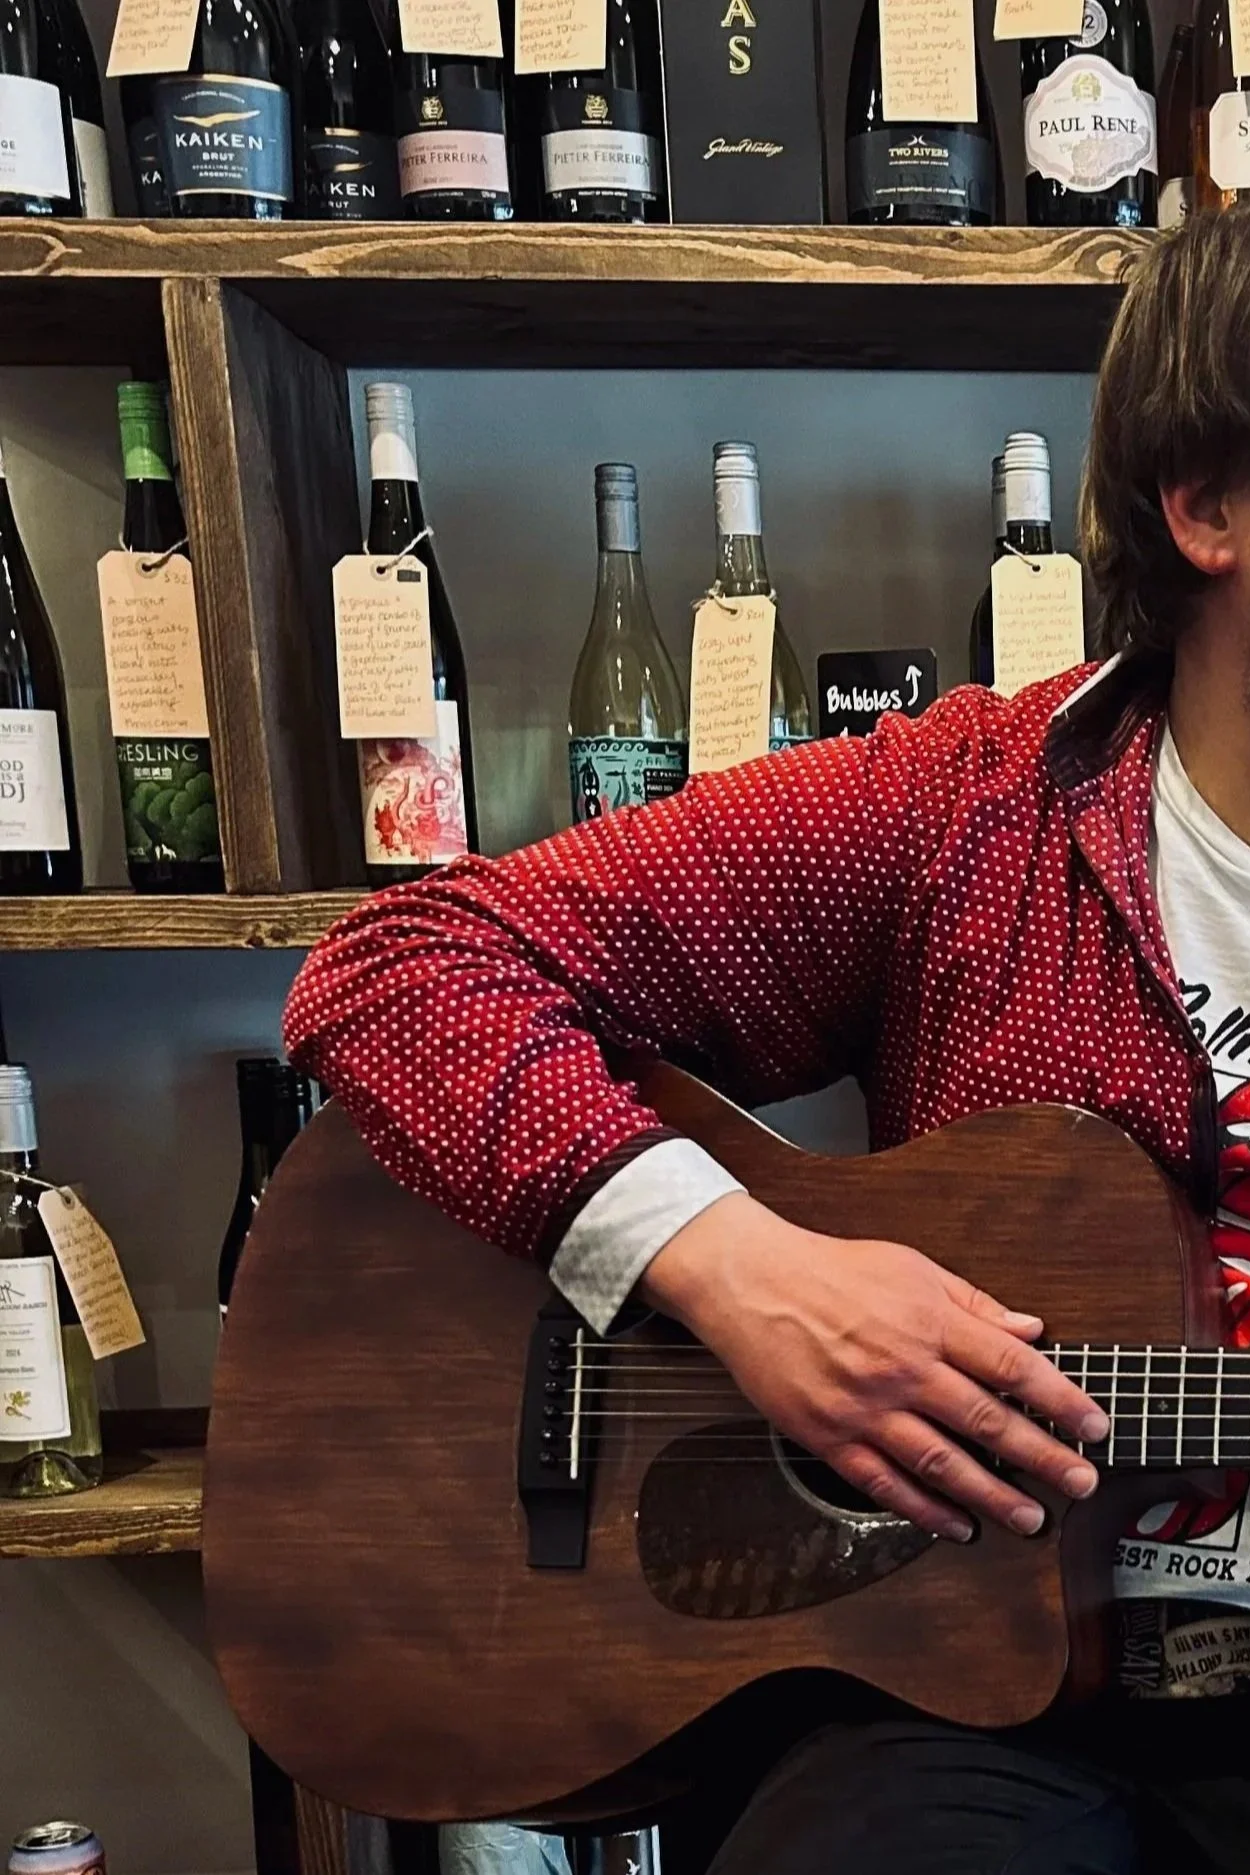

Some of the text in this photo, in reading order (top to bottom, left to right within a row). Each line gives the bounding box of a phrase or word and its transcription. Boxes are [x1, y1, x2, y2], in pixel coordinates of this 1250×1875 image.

[1039, 115, 1138, 138] PAUL RENÉ
[175, 132, 264, 151] KAIKEN
[202, 151, 236, 162] BRUT
[429, 150, 489, 165] FERREIRA
[553, 150, 651, 167] PIETER FERREIRA
[888, 147, 949, 158] TWO RIVERS
[826, 684, 903, 714] Bubbles
[1165, 1552, 1238, 1581] ROCK
